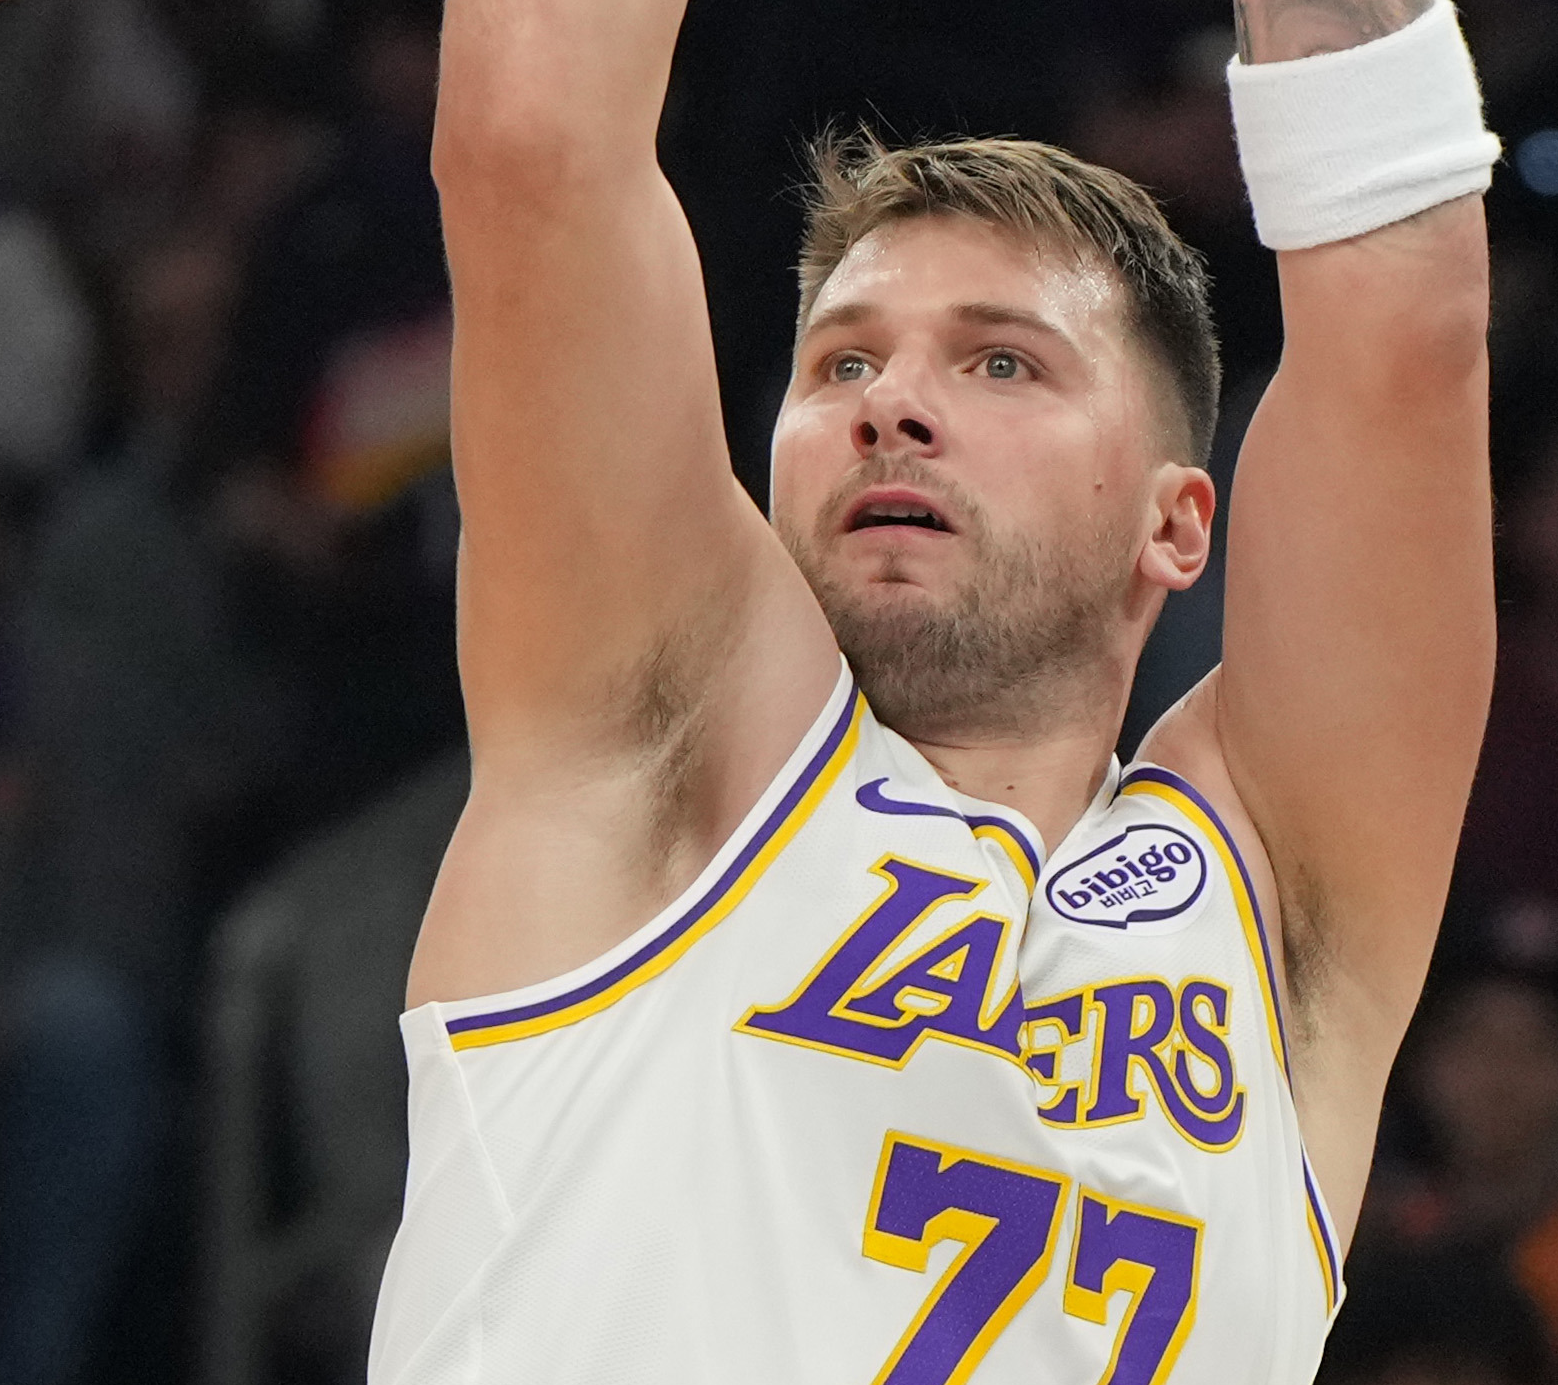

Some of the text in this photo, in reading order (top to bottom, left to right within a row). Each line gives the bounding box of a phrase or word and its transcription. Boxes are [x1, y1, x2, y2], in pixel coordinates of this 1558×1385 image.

[1057, 842, 1193, 909] bibigo
[1099, 879, 1158, 909] 비비고
[732, 852, 1246, 1153] LAERS
